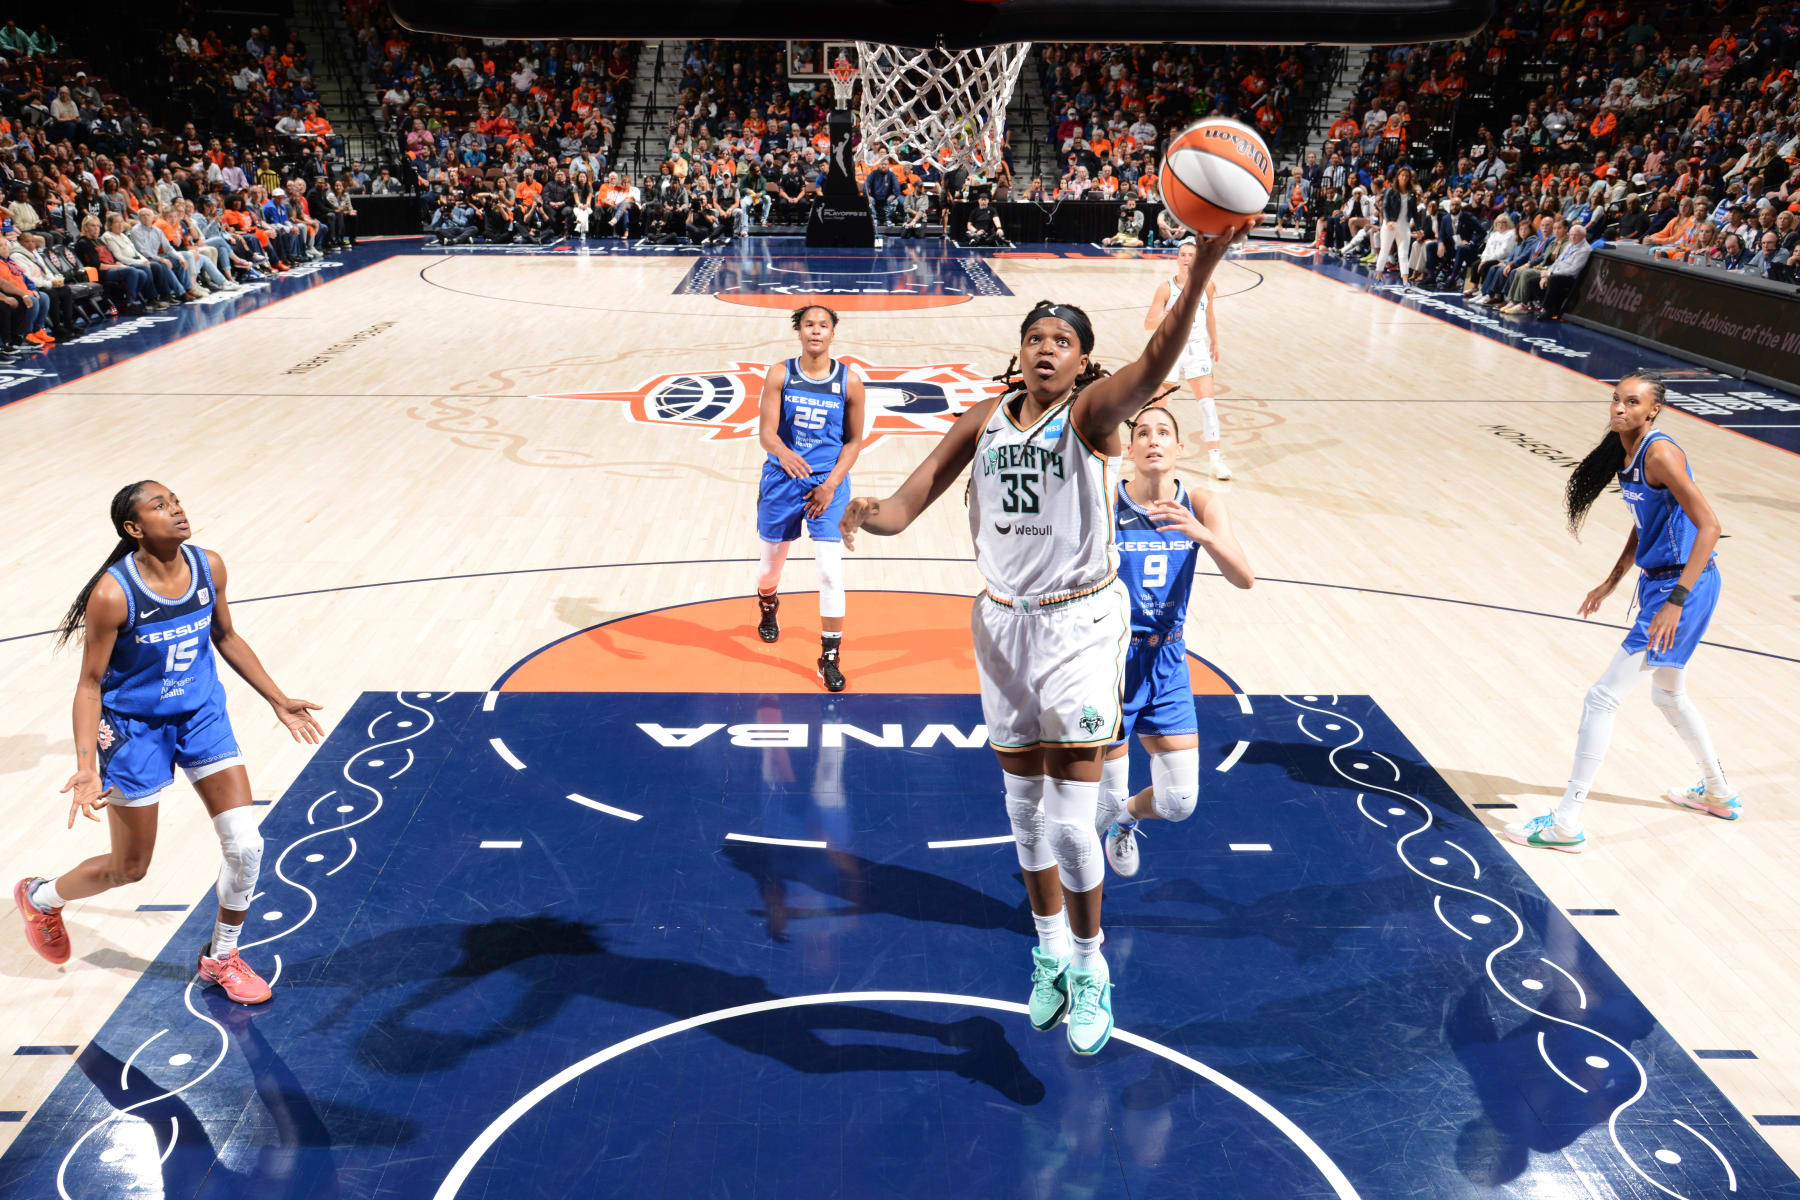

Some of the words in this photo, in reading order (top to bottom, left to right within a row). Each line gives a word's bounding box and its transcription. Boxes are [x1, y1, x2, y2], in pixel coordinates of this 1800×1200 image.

[1205, 129, 1269, 176] Wilson
[1586, 276, 1643, 313] Deloitte
[1659, 300, 1703, 326] Trusted
[1700, 311, 1746, 337] Advisor
[1741, 324, 1760, 342] of
[1757, 327, 1781, 348] the
[279, 356, 334, 374] ARENA
[784, 394, 841, 409] KEESUSK
[793, 405, 829, 430] 25
[982, 444, 1066, 481] LIBERTY
[1000, 473, 1040, 514] 35
[1014, 525, 1053, 536] Webull
[1112, 541, 1194, 552] KEESUSK
[1142, 554, 1168, 588] 9
[165, 636, 199, 672] 15
[636, 723, 989, 748] WNBA
